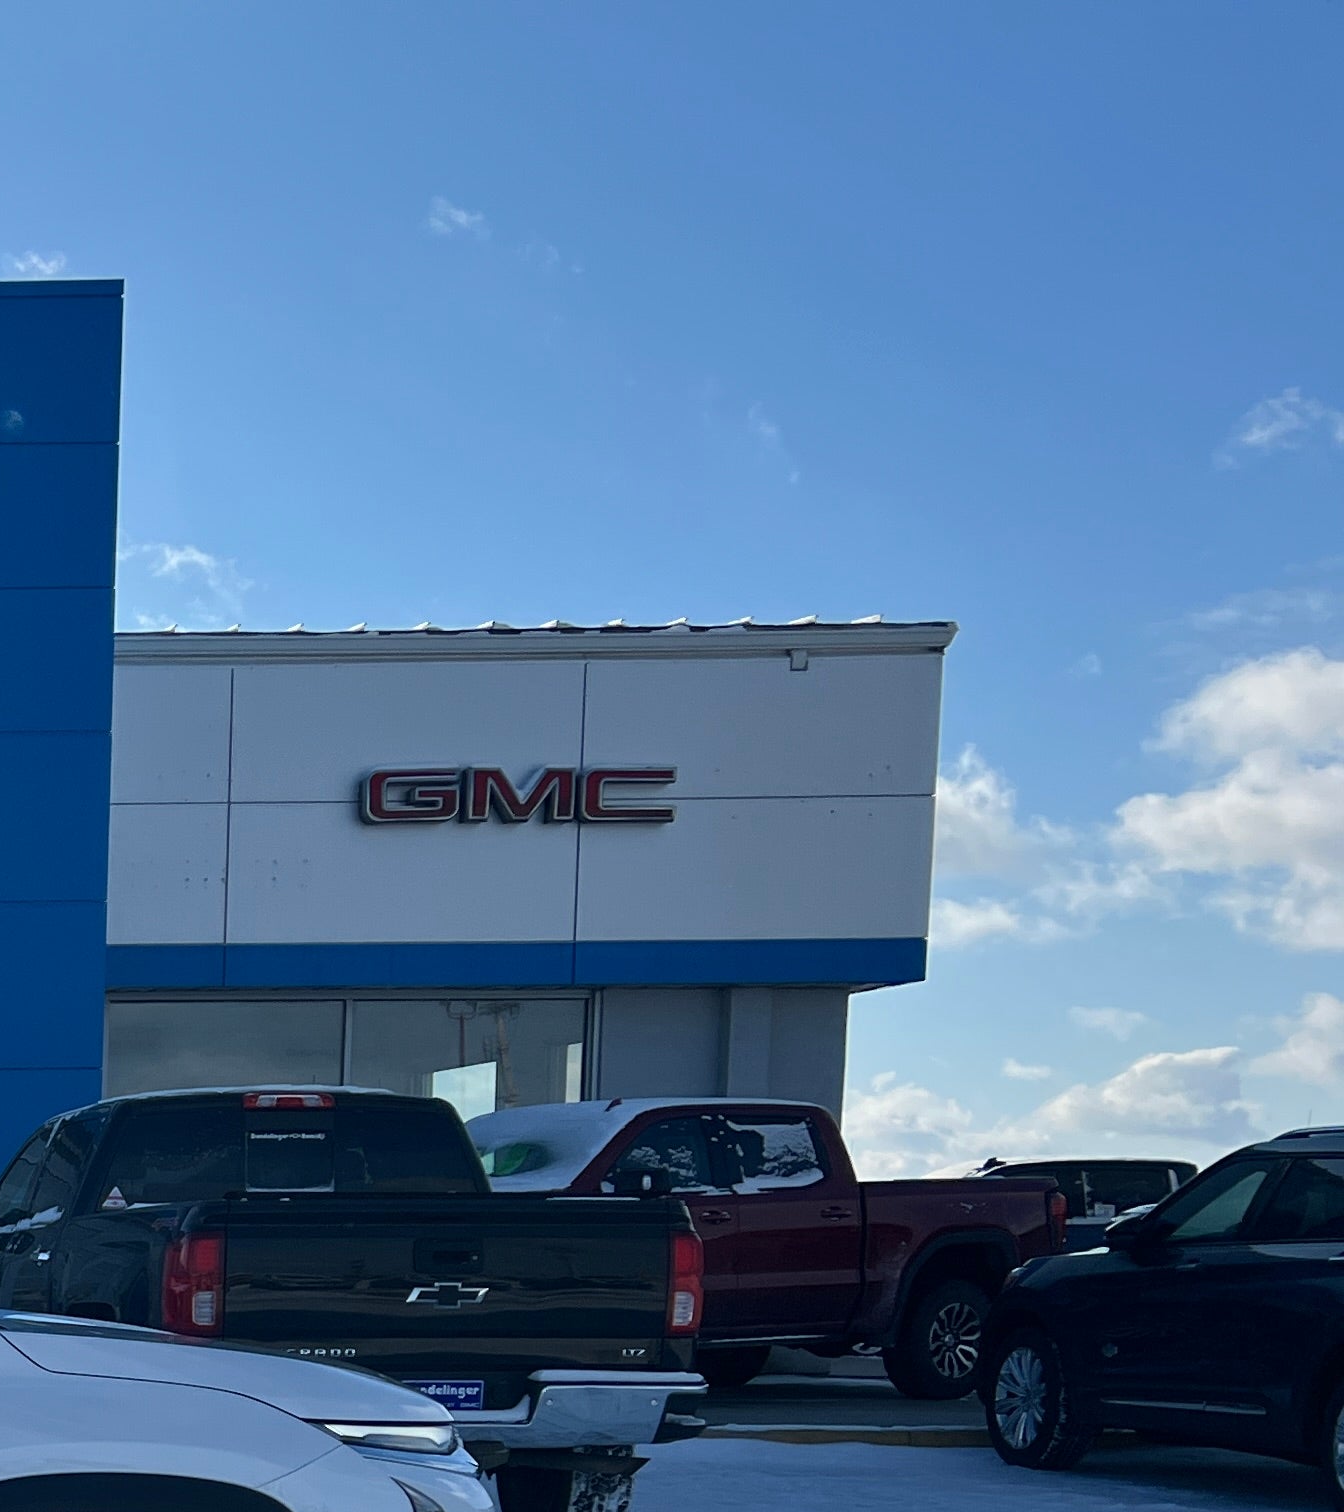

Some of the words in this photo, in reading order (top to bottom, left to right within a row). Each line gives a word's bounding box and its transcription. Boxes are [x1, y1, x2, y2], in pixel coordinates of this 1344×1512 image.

[364, 766, 677, 822] GMC
[622, 1348, 645, 1357] LTZ
[420, 1384, 480, 1399] ndelinger
